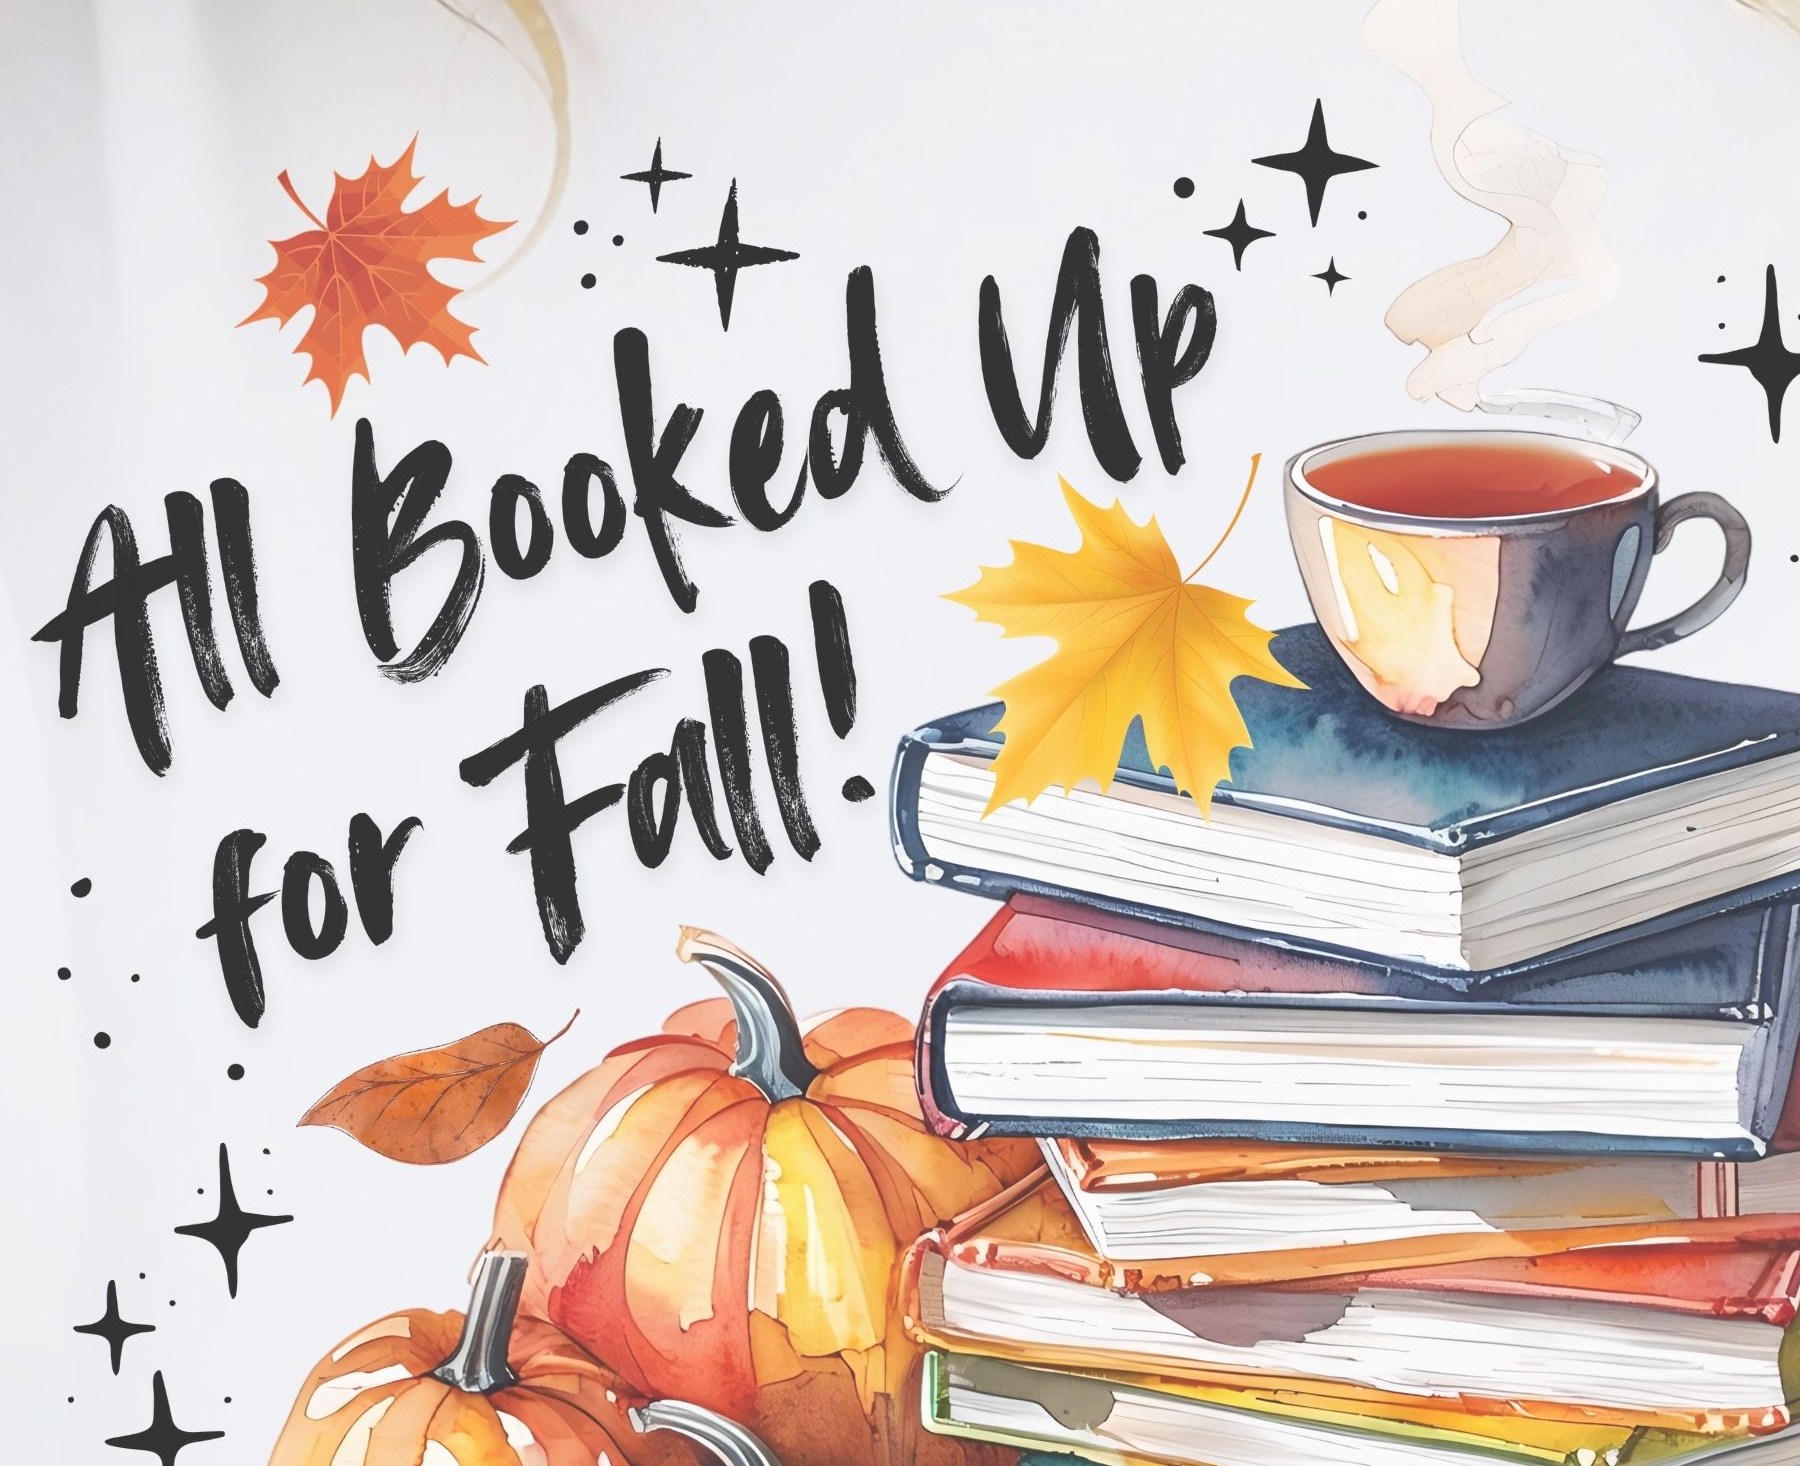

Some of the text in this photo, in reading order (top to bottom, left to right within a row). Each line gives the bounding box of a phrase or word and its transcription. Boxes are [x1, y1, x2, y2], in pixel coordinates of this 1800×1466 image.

[31, 226, 1218, 777] All Booked Up
[196, 580, 876, 1028] for Fall!
